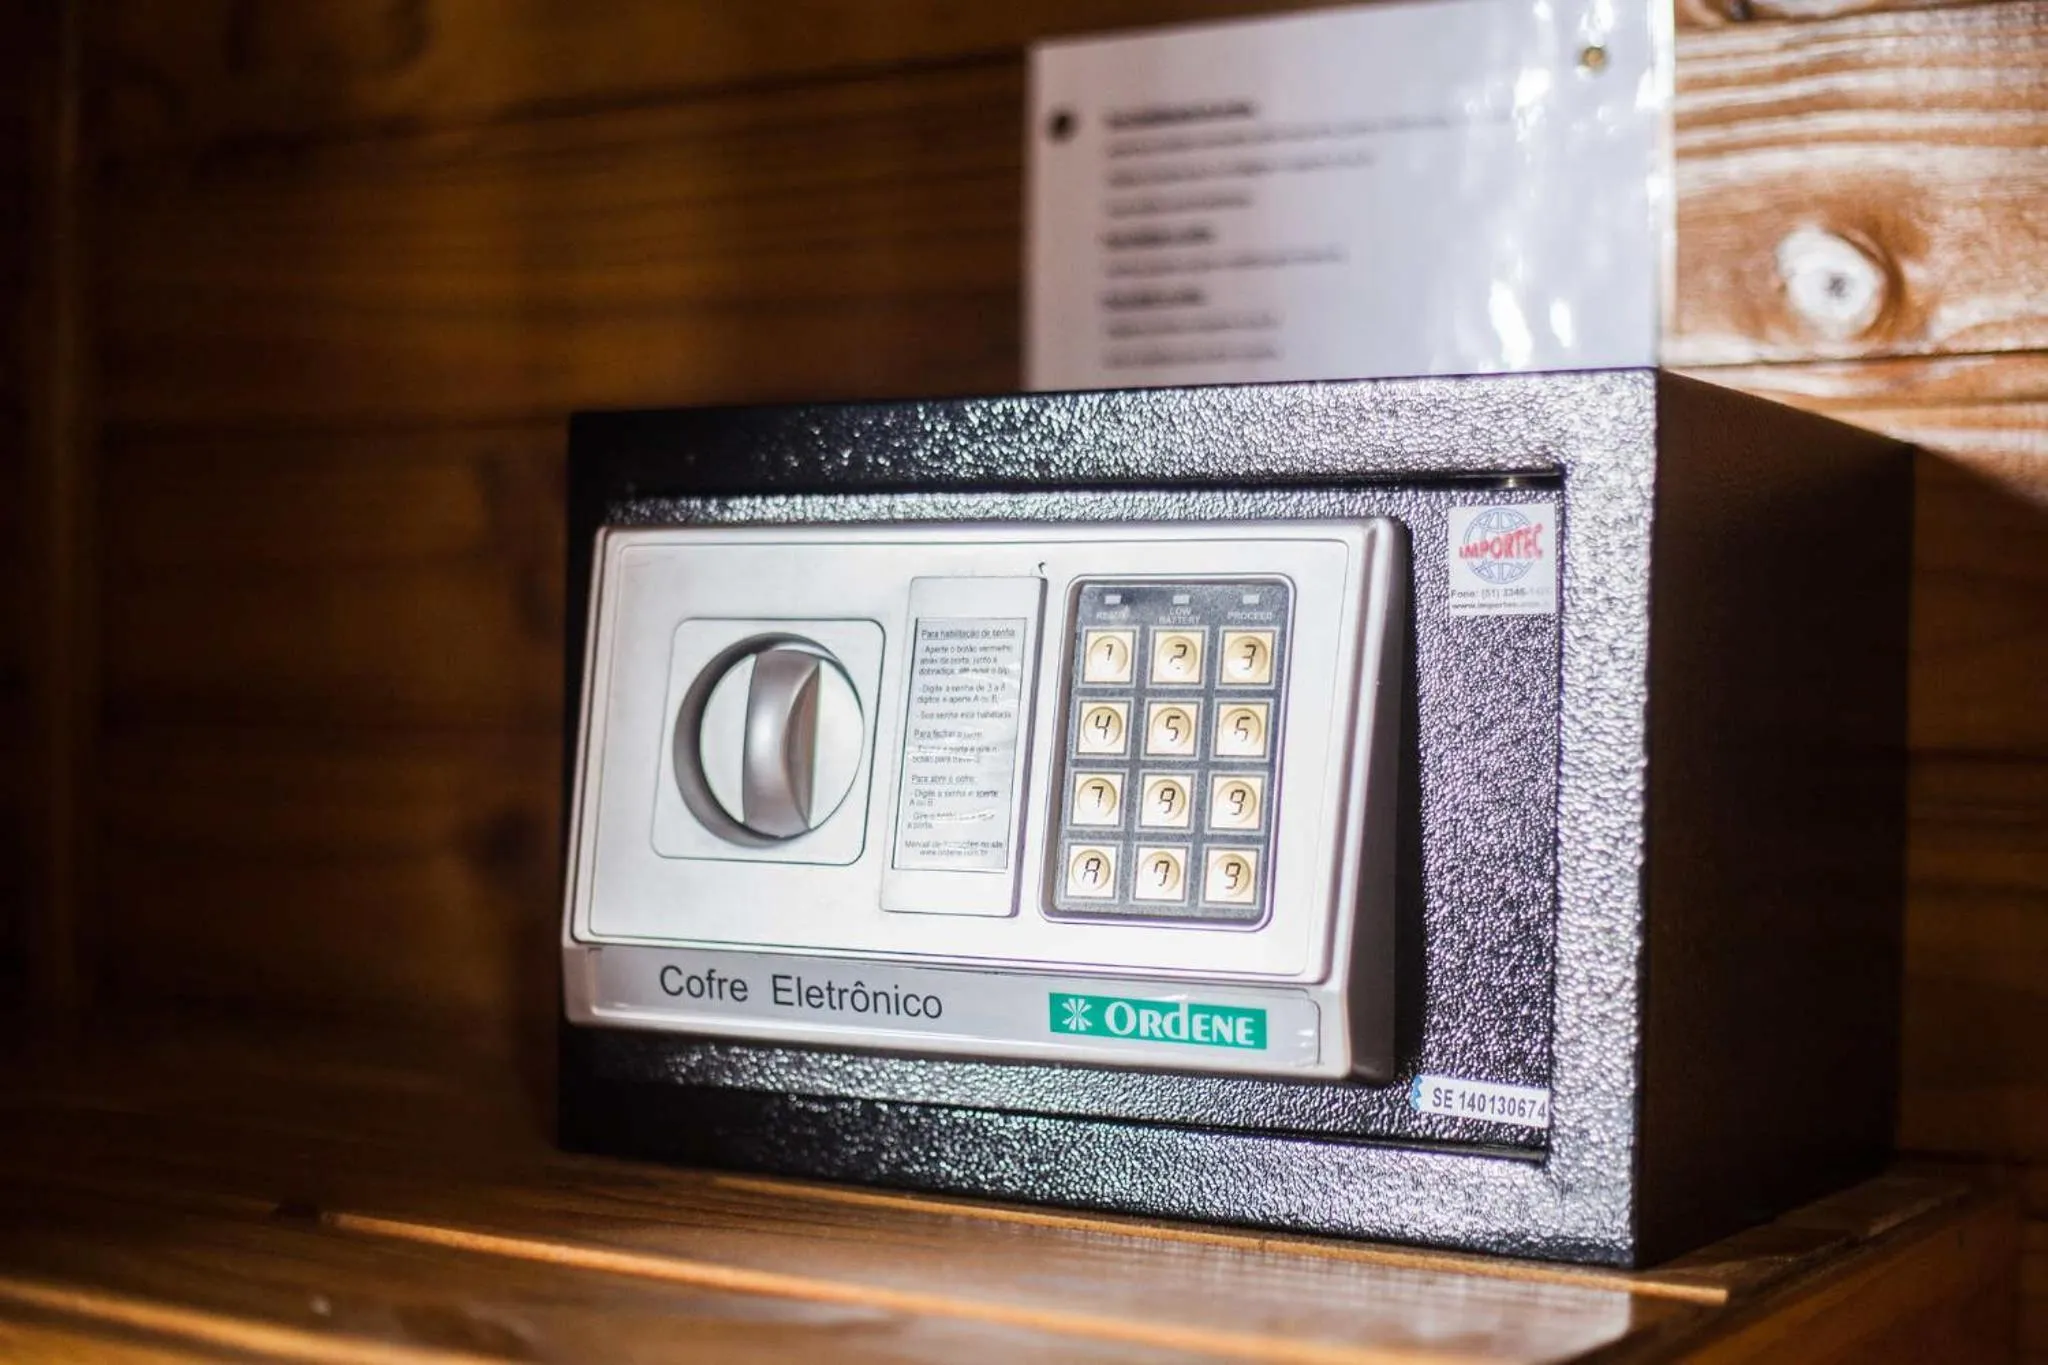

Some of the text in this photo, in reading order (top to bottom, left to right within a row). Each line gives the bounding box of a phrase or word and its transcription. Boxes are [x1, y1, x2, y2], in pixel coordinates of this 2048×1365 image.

[1458, 522, 1543, 561] IMPORTEC
[1158, 616, 1201, 625] BATTERY
[1170, 608, 1191, 616] LOW
[1228, 612, 1274, 621] PROCEED
[921, 628, 1015, 639] Para habilitação de senha
[925, 645, 948, 654] Aperte
[957, 645, 977, 653] botão
[1169, 643, 1188, 671] 2
[1240, 643, 1257, 671] 3
[914, 729, 932, 739] Para
[1094, 714, 1112, 741] 4
[1165, 715, 1181, 743] 5
[912, 775, 929, 784] Para
[1091, 785, 1105, 809] 7
[1229, 788, 1246, 816] 9
[1083, 857, 1102, 885] A
[659, 964, 944, 1021] Cofre Eletrônico
[1431, 1087, 1548, 1121] SE 140130674
